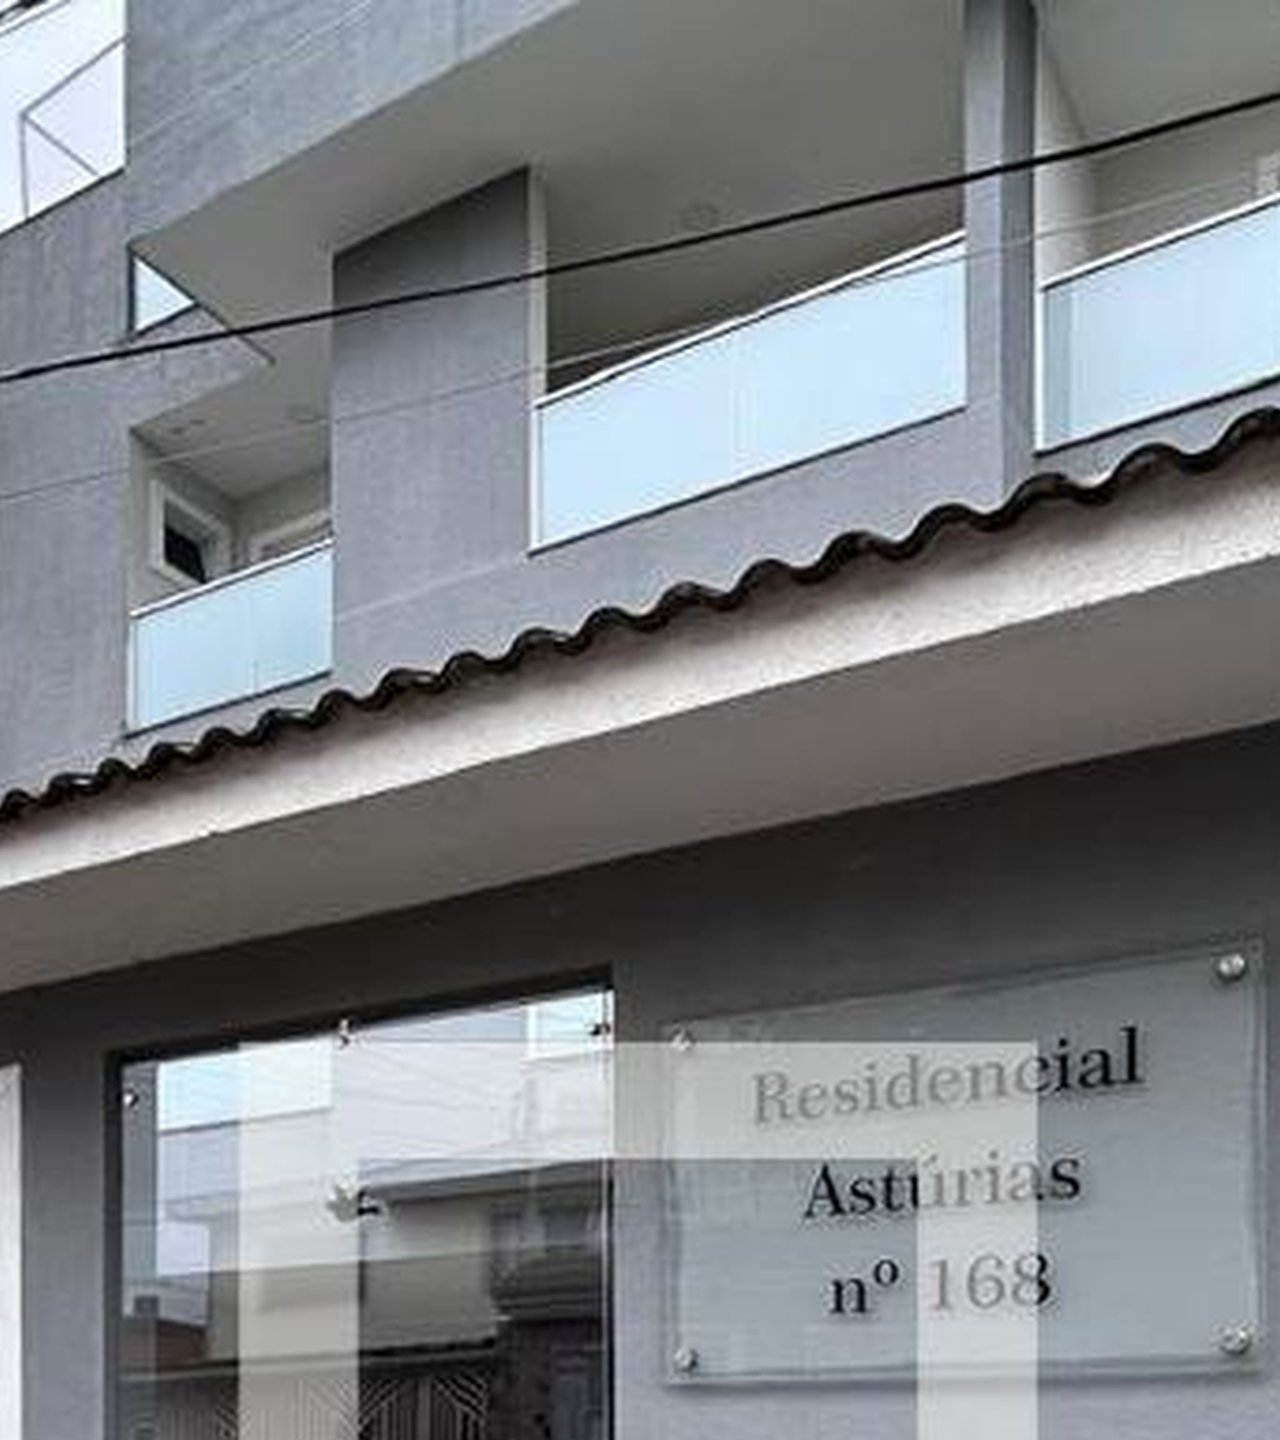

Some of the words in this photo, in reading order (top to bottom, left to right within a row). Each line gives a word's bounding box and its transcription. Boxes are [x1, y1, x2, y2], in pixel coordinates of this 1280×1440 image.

[753, 1025, 1144, 1126] Residencial
[803, 1151, 1081, 1218] Astúrias
[930, 1254, 1053, 1311] 168
